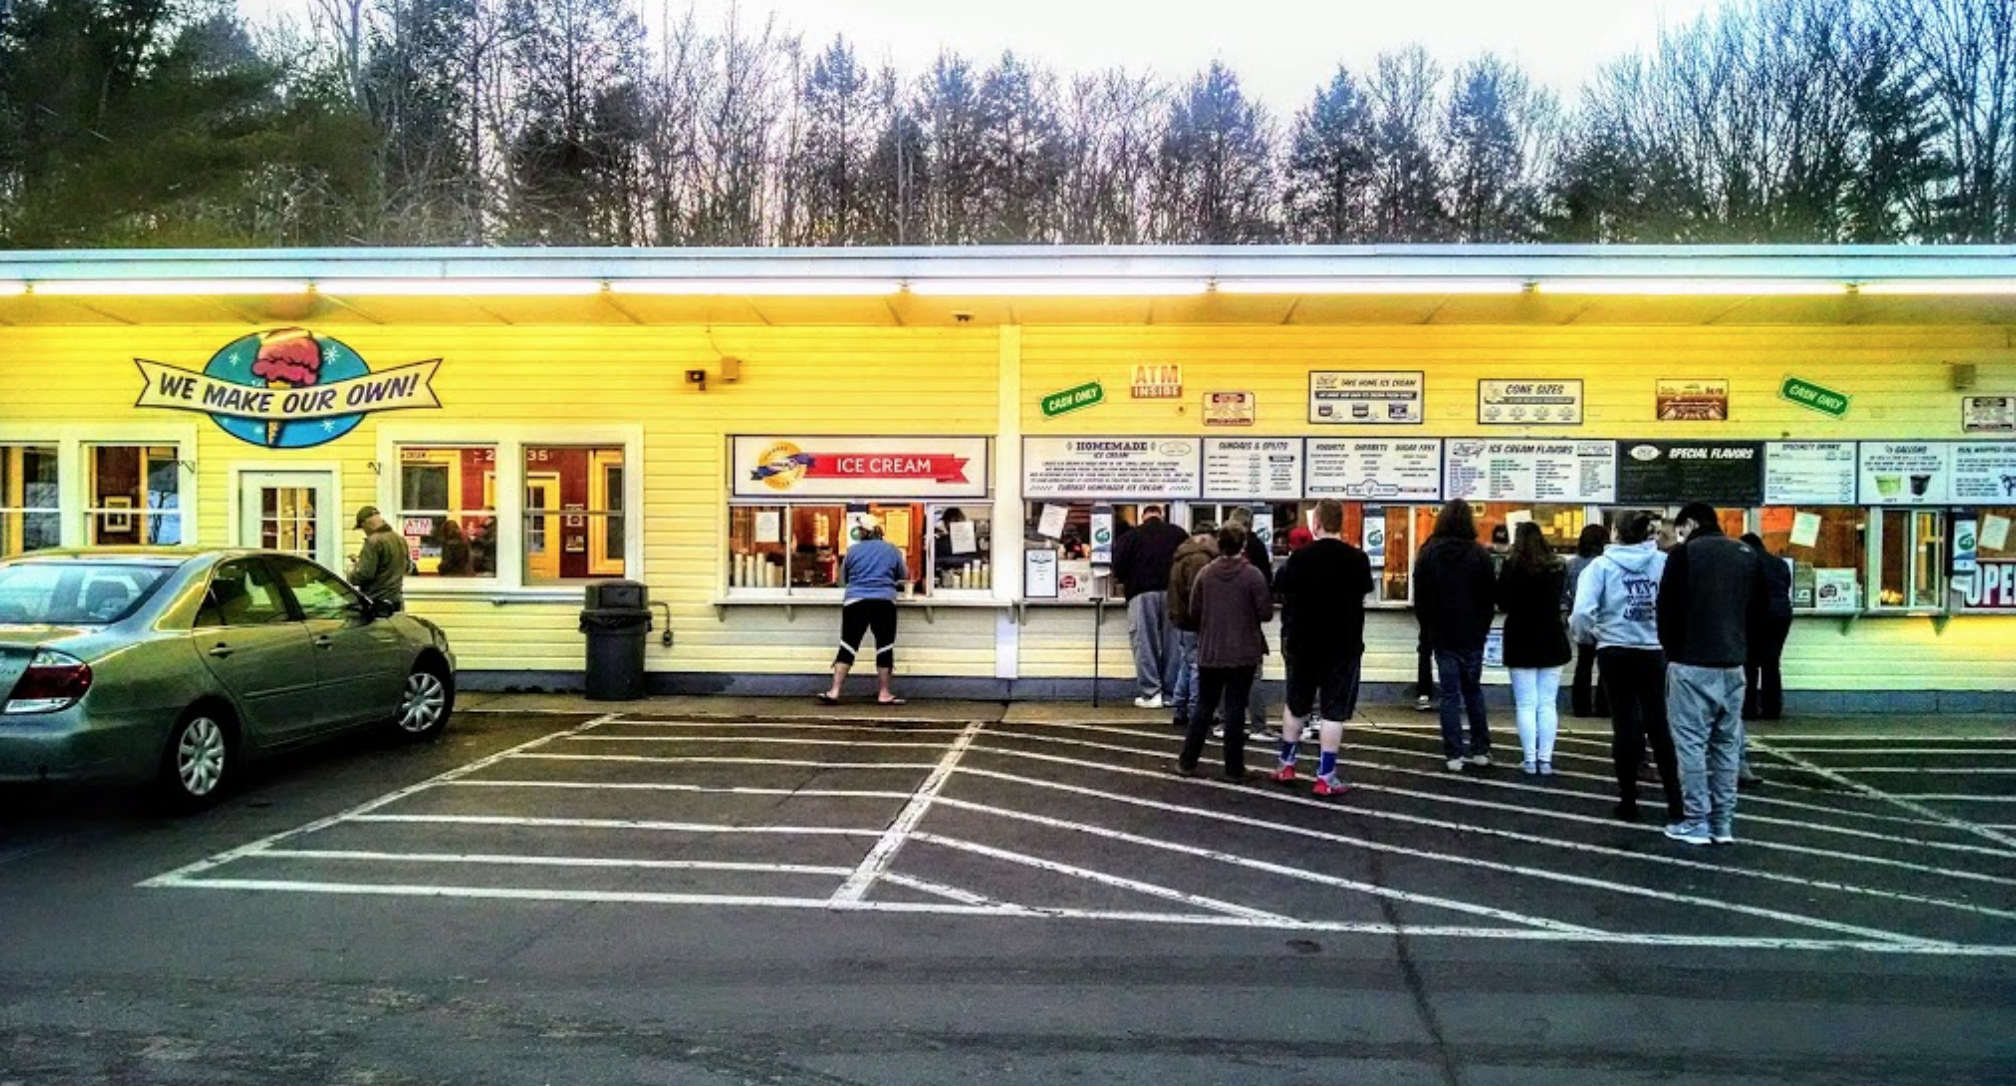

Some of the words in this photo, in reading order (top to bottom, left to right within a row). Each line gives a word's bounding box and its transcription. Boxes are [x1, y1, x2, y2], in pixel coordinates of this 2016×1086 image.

[1135, 365, 1178, 383] ATM
[159, 372, 198, 399] WE
[202, 383, 272, 412] MAKE
[281, 391, 338, 414] OUR
[346, 373, 420, 406] OWN!
[1134, 385, 1180, 397] INSIDE
[1505, 384, 1533, 395] CONE
[1536, 384, 1564, 395] SIZES
[1049, 395, 1073, 412] CASH
[1075, 386, 1099, 403] ONLY
[1789, 384, 1816, 401] CASH
[1817, 394, 1844, 409] ONLY
[1076, 442, 1148, 450] HOMEMADE
[1488, 445, 1501, 453] ICE
[1504, 445, 1534, 453] CREAM
[1535, 445, 1574, 454] FLAVORS
[1669, 448, 1707, 459] SPECIAL
[1711, 448, 1754, 459] FLAVORS
[838, 458, 864, 473] ICE
[870, 458, 931, 473] CREAM
[406, 520, 429, 529] ATM
[1965, 564, 2016, 605] OPE
